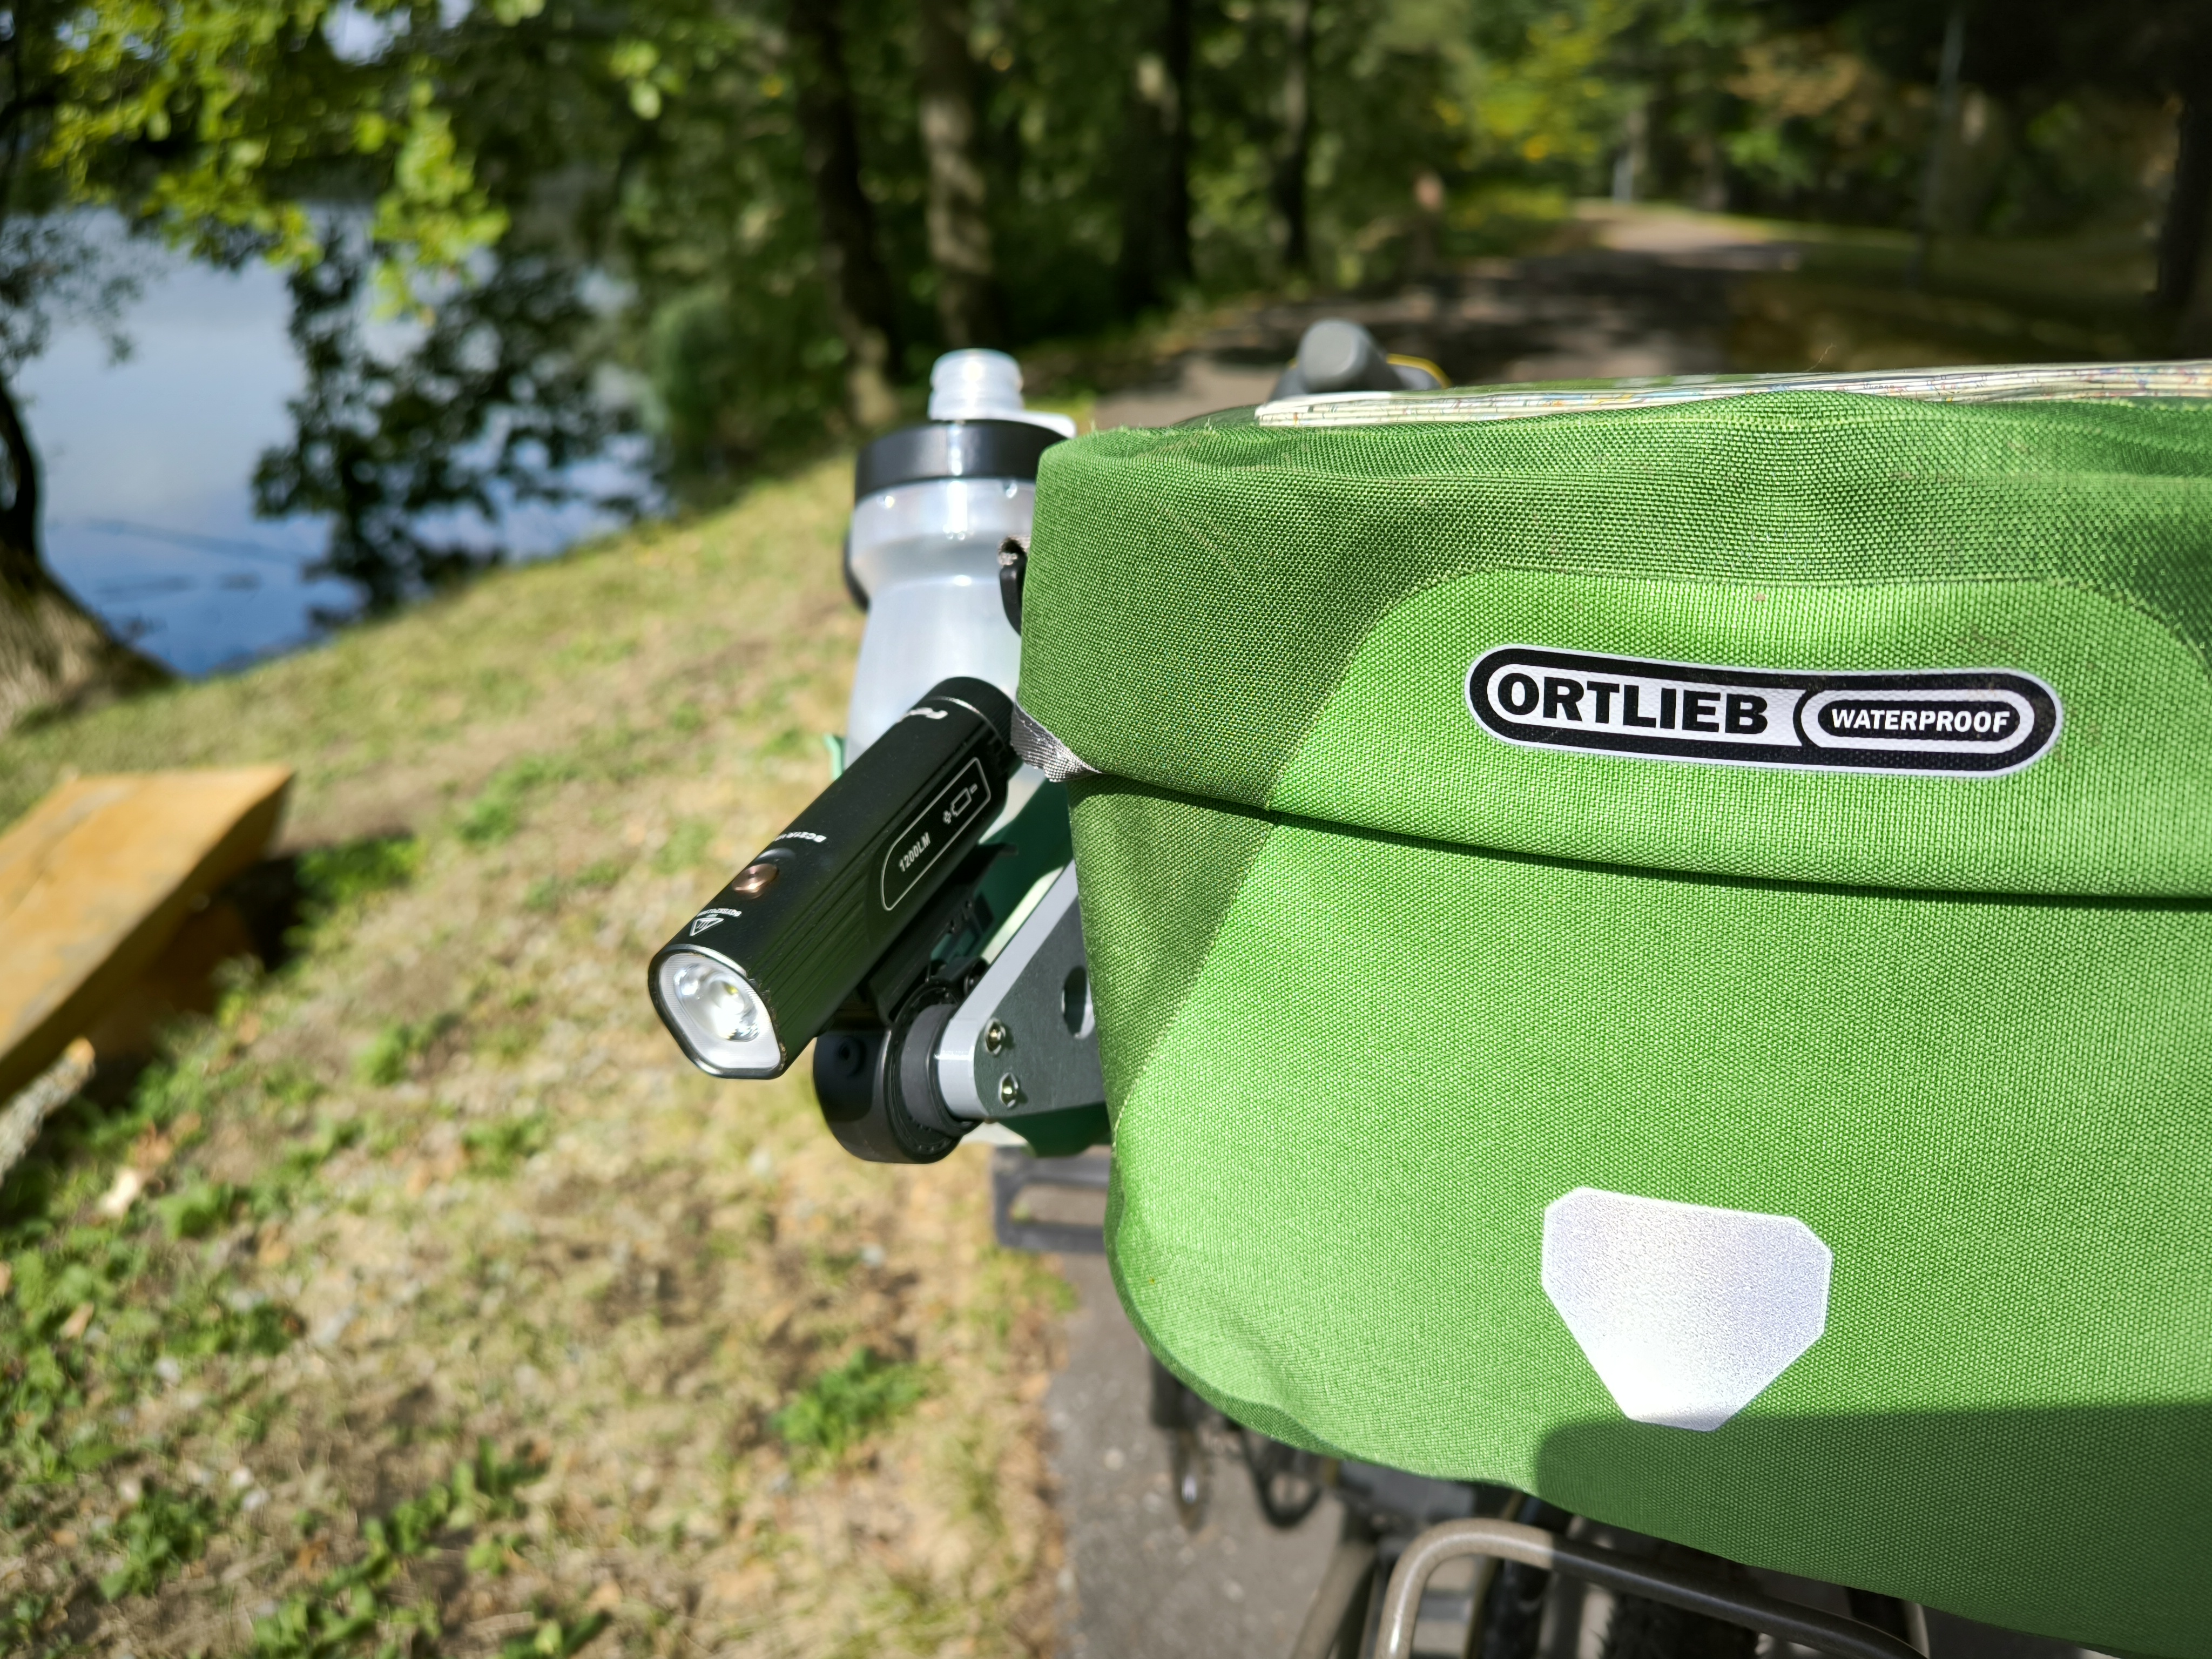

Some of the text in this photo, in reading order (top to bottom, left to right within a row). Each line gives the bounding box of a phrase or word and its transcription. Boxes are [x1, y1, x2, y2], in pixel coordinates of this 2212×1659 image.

[1498, 672, 2010, 735] ORTLIEB WATERPROOF
[899, 832, 931, 872] 1200LM
